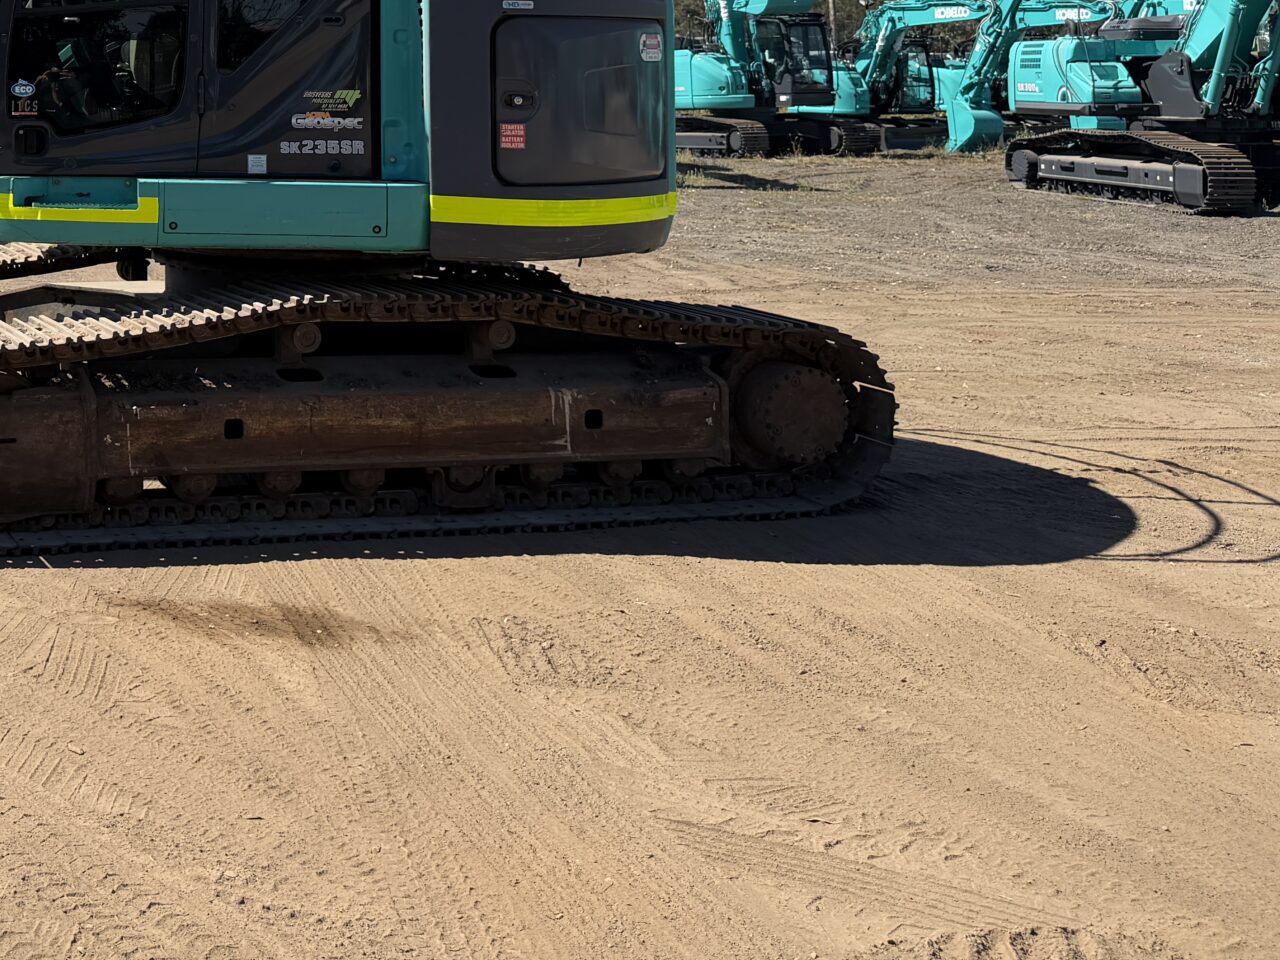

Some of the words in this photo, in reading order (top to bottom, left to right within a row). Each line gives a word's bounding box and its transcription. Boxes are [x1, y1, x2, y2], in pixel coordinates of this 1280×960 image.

[934, 6, 970, 19] KOBELCO
[291, 113, 364, 132] Geospec
[280, 139, 365, 154] SK235SR
